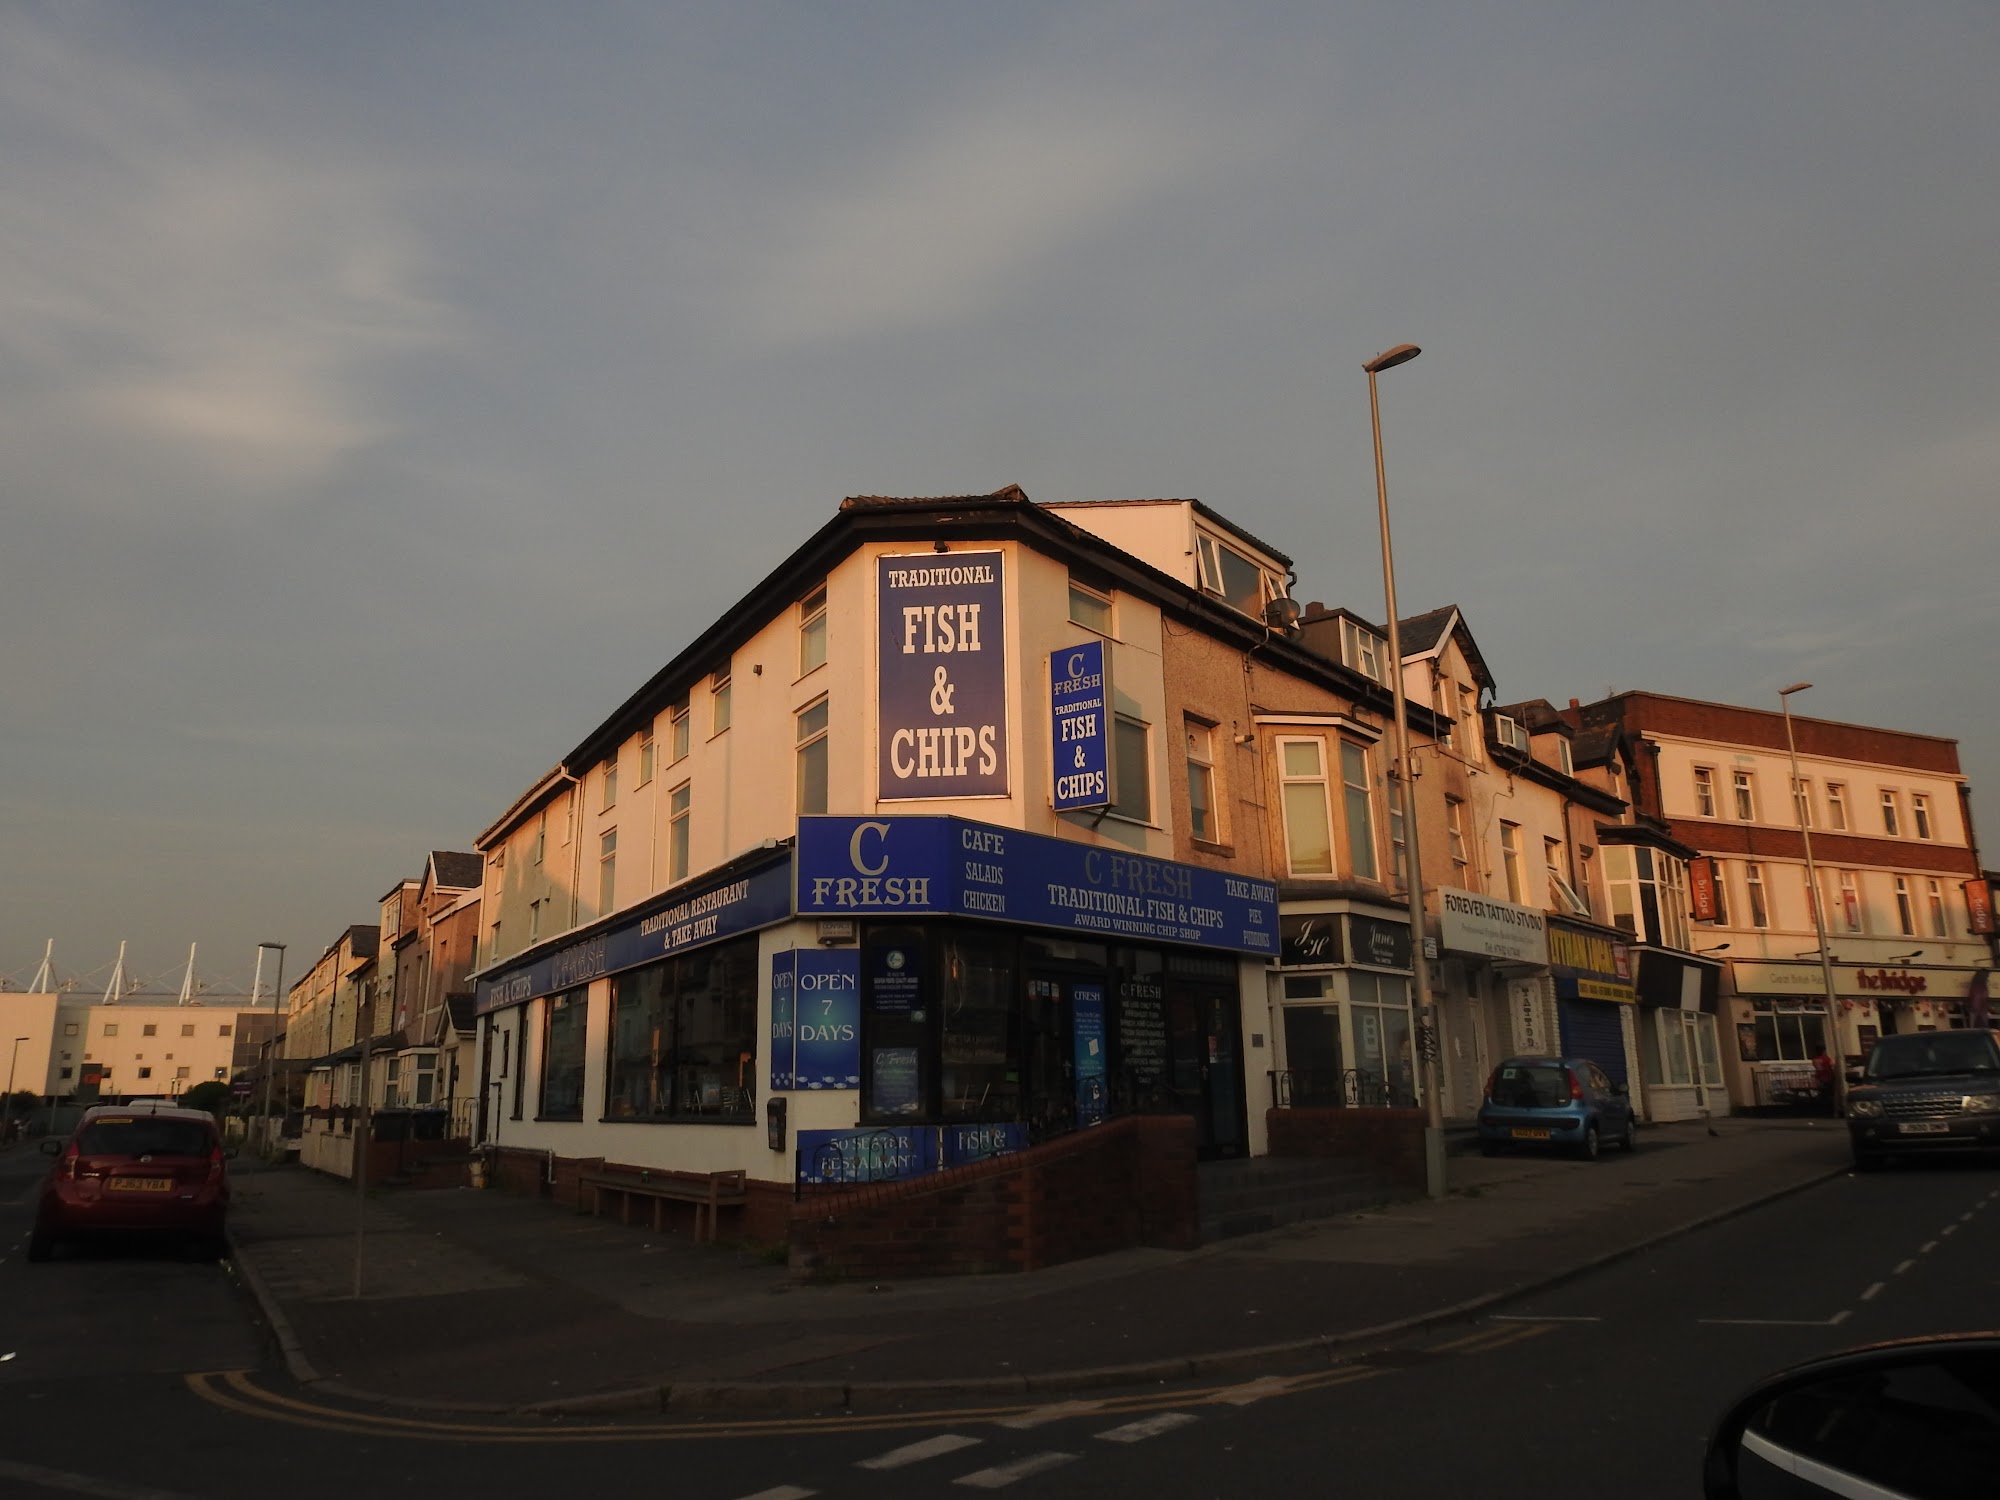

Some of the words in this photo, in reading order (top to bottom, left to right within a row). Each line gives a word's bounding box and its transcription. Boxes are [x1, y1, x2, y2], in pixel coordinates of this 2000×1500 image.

[888, 565, 994, 588] TRADITIONAL
[902, 603, 981, 654] FISH
[1067, 653, 1085, 678] C
[930, 665, 955, 715] &
[1053, 673, 1101, 696] FRESH
[1054, 698, 1102, 715] TRADITIONAL
[1061, 713, 1097, 742] FISH
[890, 725, 997, 779] CHIPS
[1073, 745, 1086, 768] &
[1056, 770, 1105, 800] CHIPS
[850, 821, 891, 876] C
[962, 828, 1005, 856] CAFE
[965, 861, 1004, 885] SALADS
[1085, 850, 1102, 885] C
[1110, 856, 1193, 900] FRESH
[811, 877, 931, 908] FRESH
[963, 890, 1006, 913] CHICKEN
[1225, 878, 1250, 899] TAKE
[1251, 885, 1274, 904] AWAY
[640, 902, 690, 937] TRADITIONAL
[690, 878, 749, 916] RESTAURANT
[1047, 883, 1144, 918] TRADITIONAL
[1147, 899, 1175, 922] FISH
[1178, 904, 1188, 924] &
[1189, 907, 1224, 929] CHIPS
[1248, 908, 1263, 925] PIES
[1445, 894, 1486, 918] FOREVER
[1486, 903, 1515, 924] TATTOO
[663, 935, 671, 950] &
[671, 926, 692, 947] TAKE
[692, 915, 718, 940] AWAY
[1074, 913, 1111, 929] AWARD
[1113, 918, 1156, 935] WINNING
[1157, 924, 1178, 938] CHIP
[1179, 928, 1201, 941] SHOP
[1243, 929, 1270, 949] PUDDINGS
[551, 950, 560, 990] C
[560, 932, 608, 988] FRESH
[490, 984, 504, 1008] FISH
[510, 974, 532, 1001] CHIPS
[773, 972, 794, 991] OPEN
[800, 973, 855, 991] OPEN
[1120, 983, 1127, 996] C
[1130, 984, 1161, 999] FRESH
[780, 997, 786, 1013] 7
[821, 1000, 833, 1016] 7
[772, 1022, 792, 1040] DAYS
[800, 1024, 854, 1041] DAYS
[852, 1136, 908, 1150] SEATER
[958, 1132, 990, 1150] FISH
[821, 1155, 917, 1170] RESTAURANT
